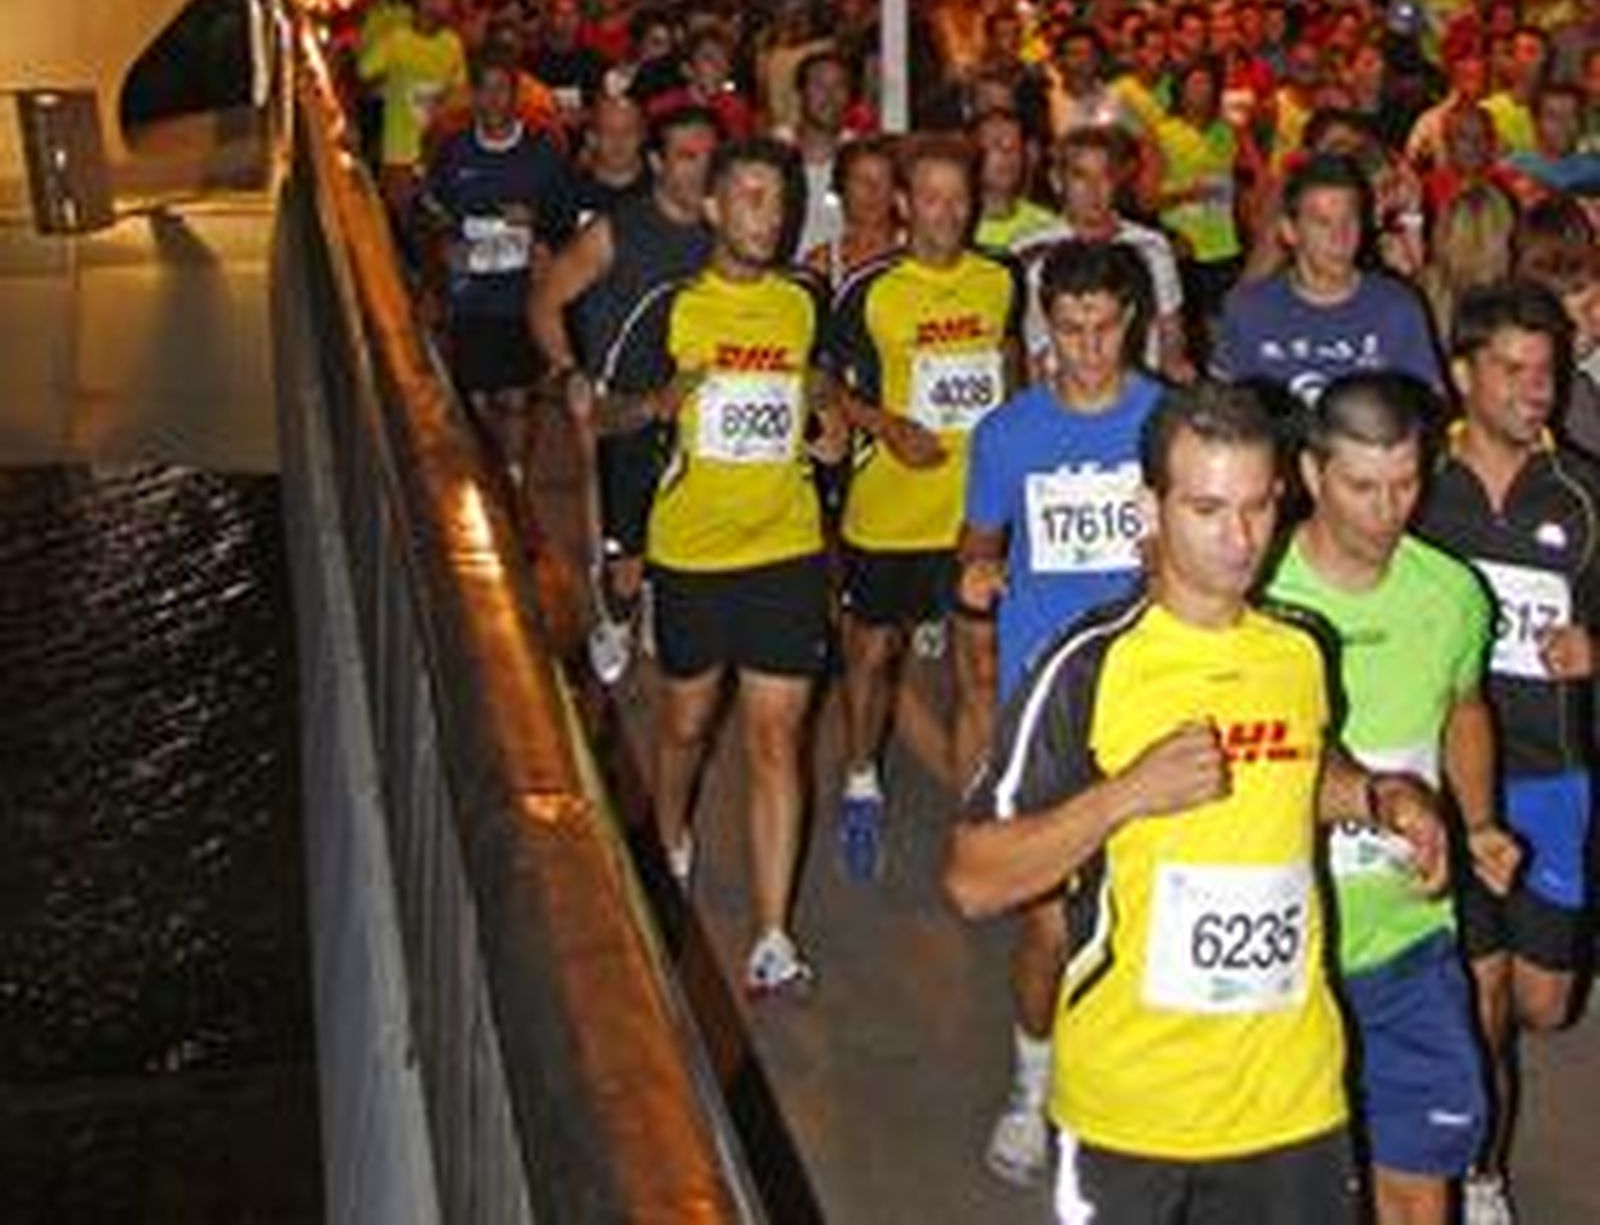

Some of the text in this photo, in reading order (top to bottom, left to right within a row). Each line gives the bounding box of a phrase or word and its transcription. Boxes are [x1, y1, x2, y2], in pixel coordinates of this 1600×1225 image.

[716, 343, 797, 370] DHL
[1041, 500, 1142, 544] 17616
[1221, 721, 1298, 762] HL
[1191, 903, 1301, 970] 6235
